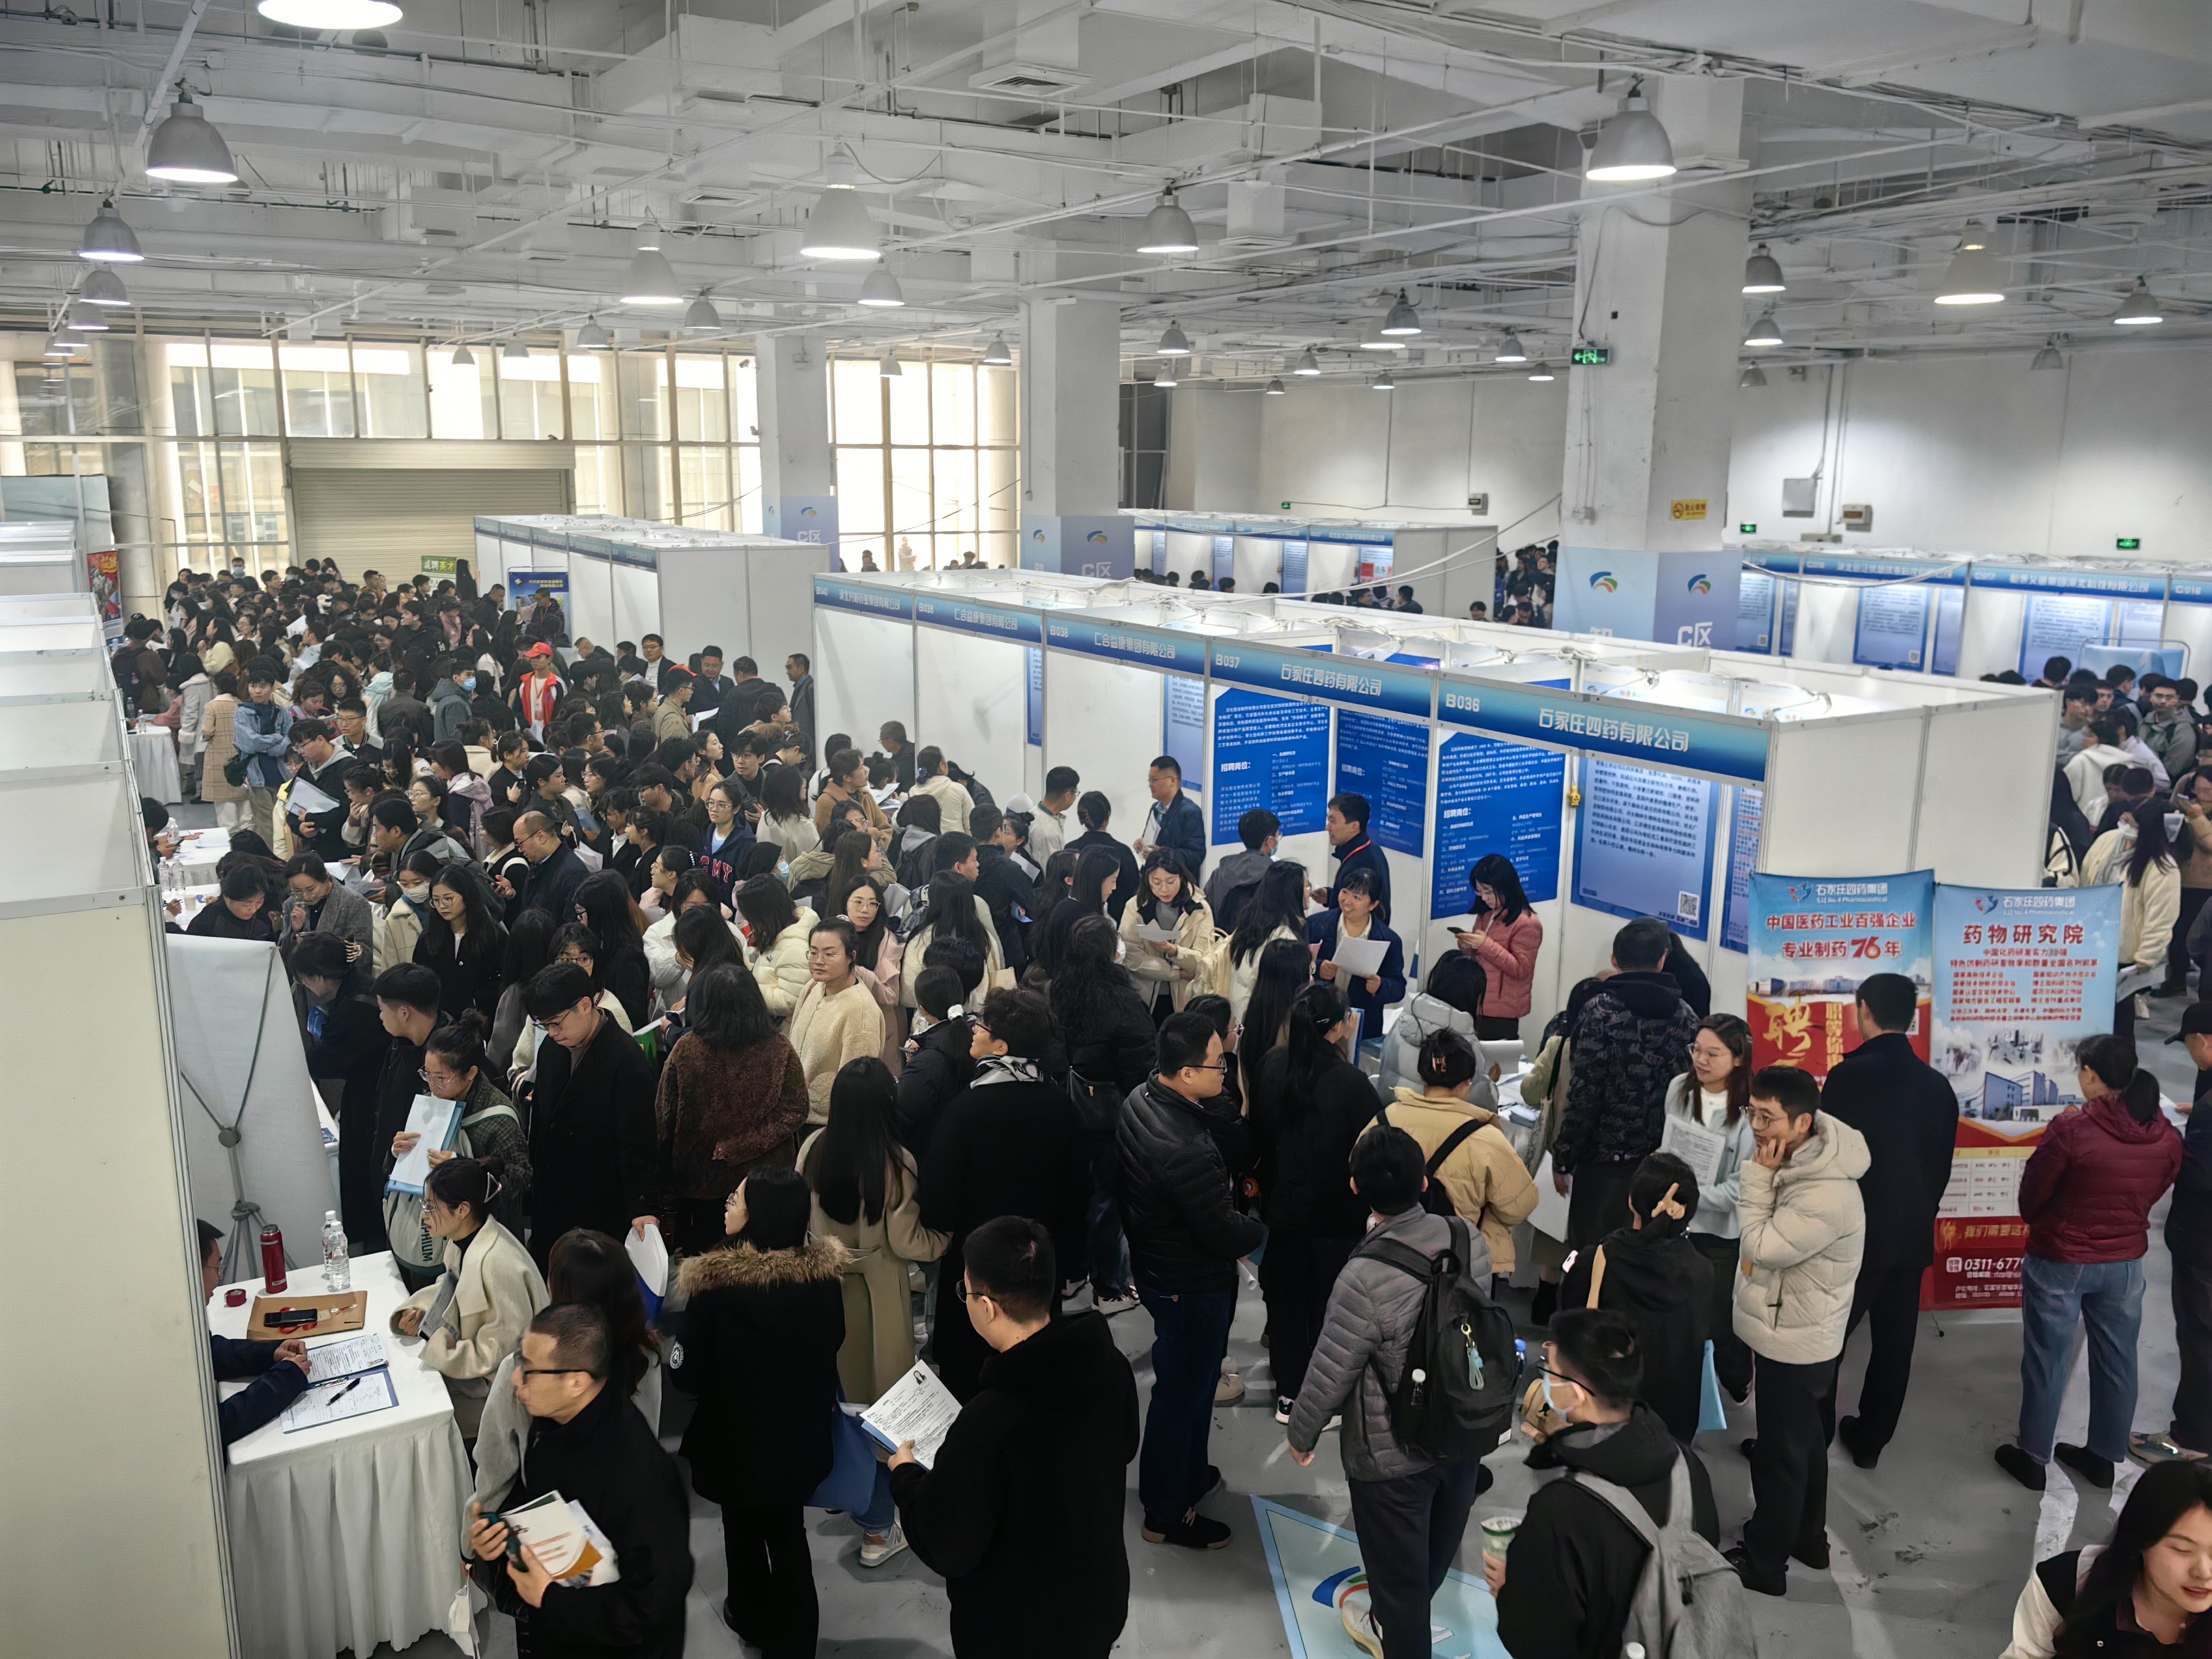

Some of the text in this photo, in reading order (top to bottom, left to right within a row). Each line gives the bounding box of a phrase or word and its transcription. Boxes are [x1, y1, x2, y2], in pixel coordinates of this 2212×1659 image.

[1050, 625, 1069, 638] B038
[1094, 630, 1176, 659] 仁合益康集团有限公司
[1215, 654, 1240, 669] B037
[1281, 663, 1381, 696] 石家庄四药有限公司
[1446, 693, 1480, 712] B036
[1539, 707, 1689, 753] 石家庄四药有限公司
[1766, 912, 1917, 932] 中国医药工业百强企业
[1963, 924, 2084, 945] 药物研究院
[1781, 936, 1902, 959] 专业制药76年
